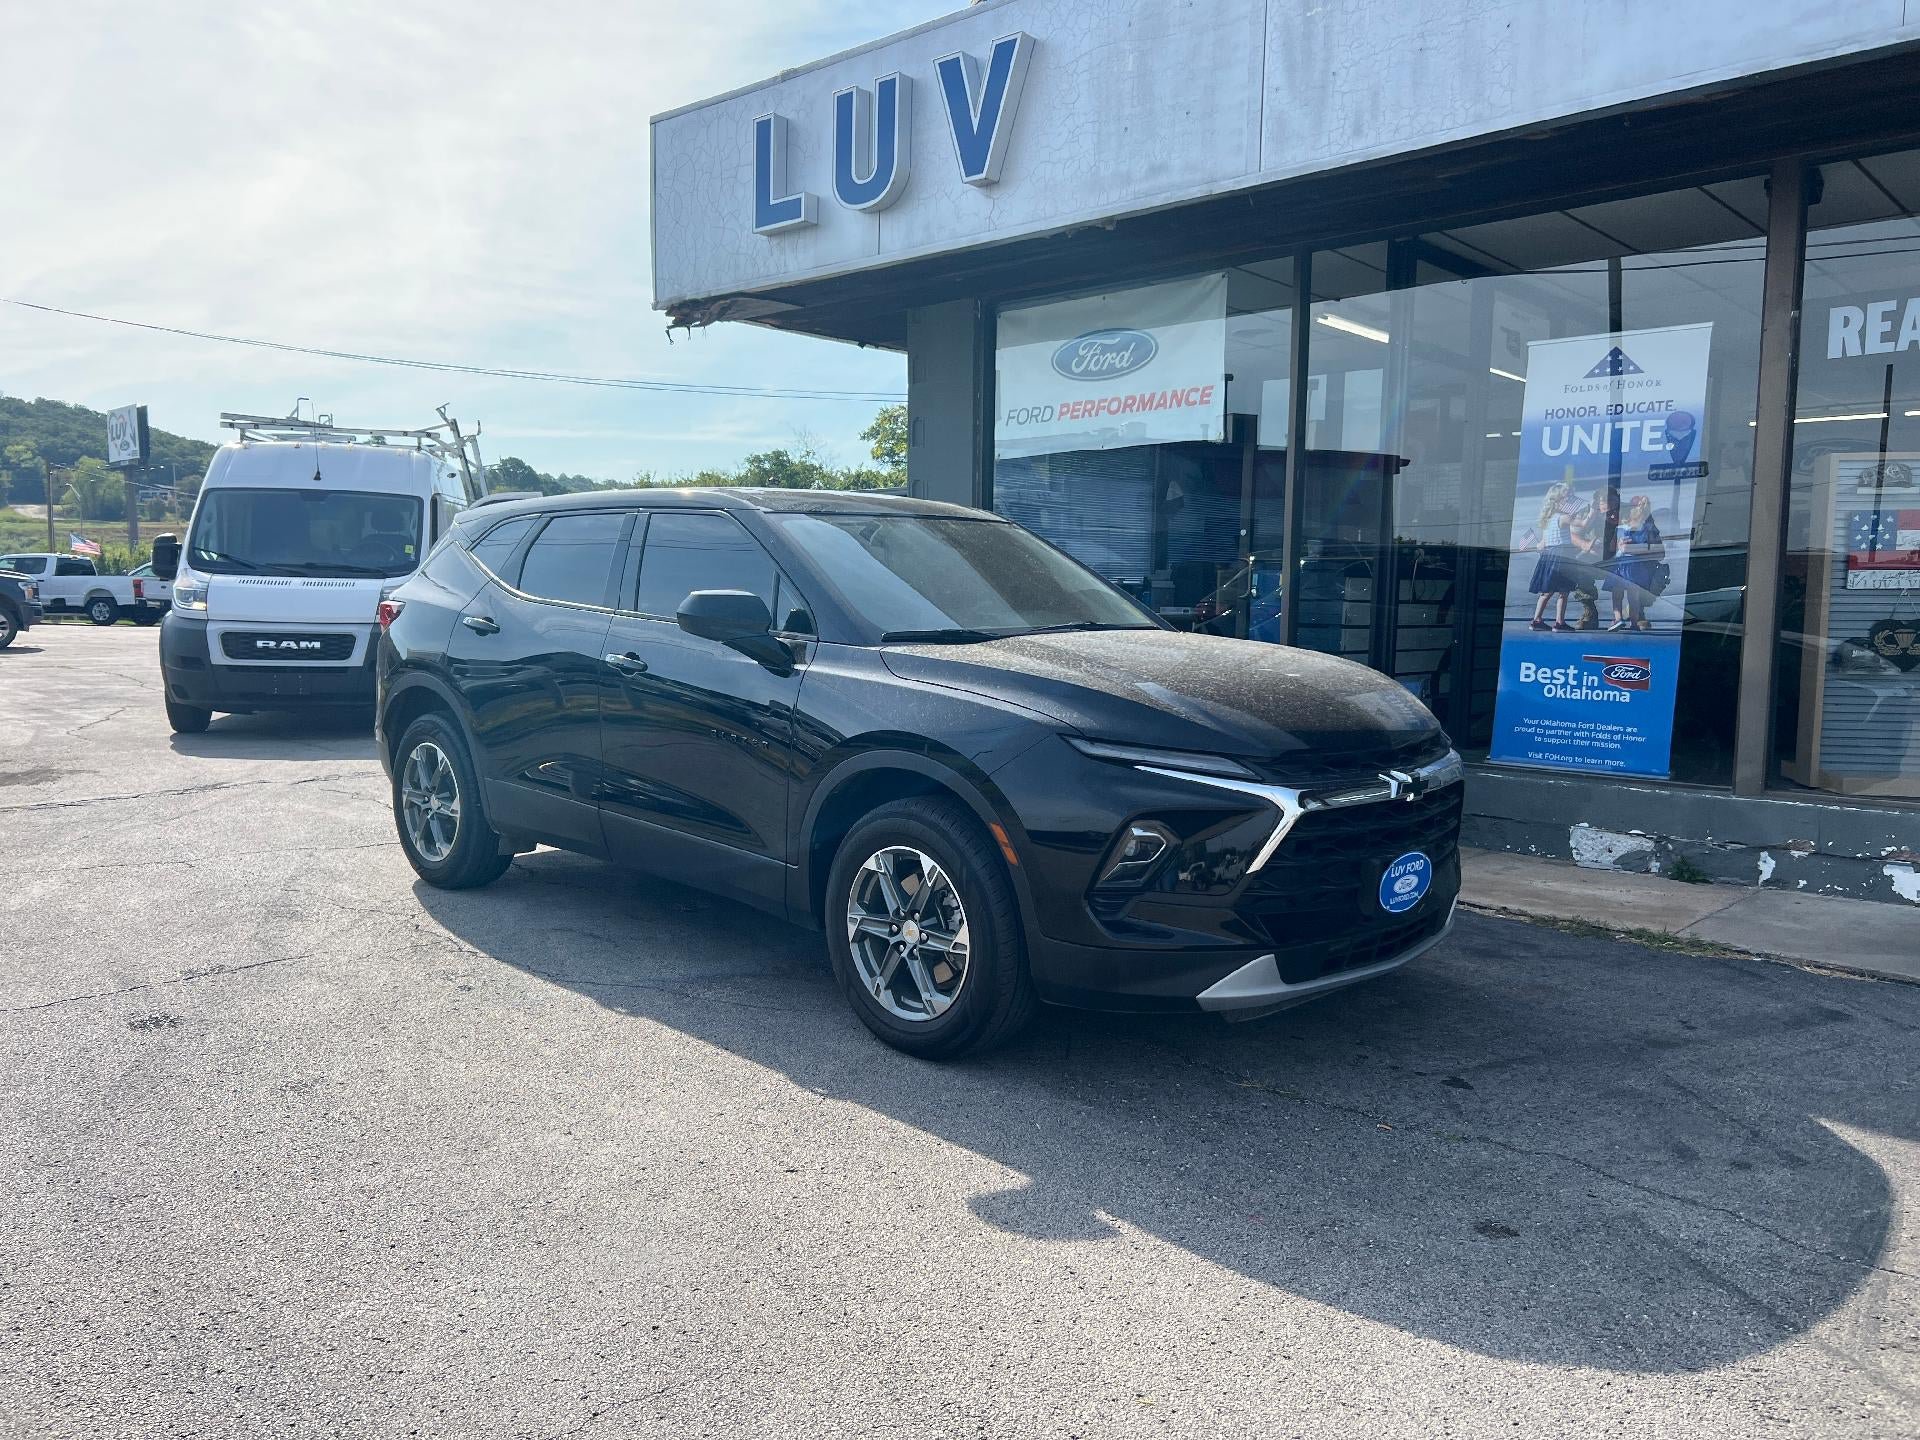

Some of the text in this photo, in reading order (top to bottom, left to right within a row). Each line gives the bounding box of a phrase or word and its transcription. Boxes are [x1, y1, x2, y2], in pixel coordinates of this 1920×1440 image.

[752, 31, 1032, 235] LUV
[1071, 337, 1135, 373] Ford
[1005, 385, 1214, 426] FORD PERFORMANCE
[1545, 400, 1677, 420] HONOR. EDUCATE.
[256, 640, 321, 649] RAM
[1519, 662, 1599, 686] Best in
[1610, 666, 1642, 680] Ford
[1543, 684, 1631, 702] Oklahoma
[1523, 717, 1539, 725] Your
[1540, 719, 1576, 728] Oklahoma
[1578, 722, 1595, 730] Ford
[1596, 723, 1623, 732] Dealers
[1543, 737, 1572, 746] support
[1573, 738, 1590, 746] their
[1545, 728, 1572, 737] partner
[1573, 730, 1590, 738] with
[1591, 731, 1612, 740] Folds
[1622, 734, 1646, 742] Honor
[1527, 751, 1543, 759] Visit
[1391, 860, 1424, 877] LUV FORD
